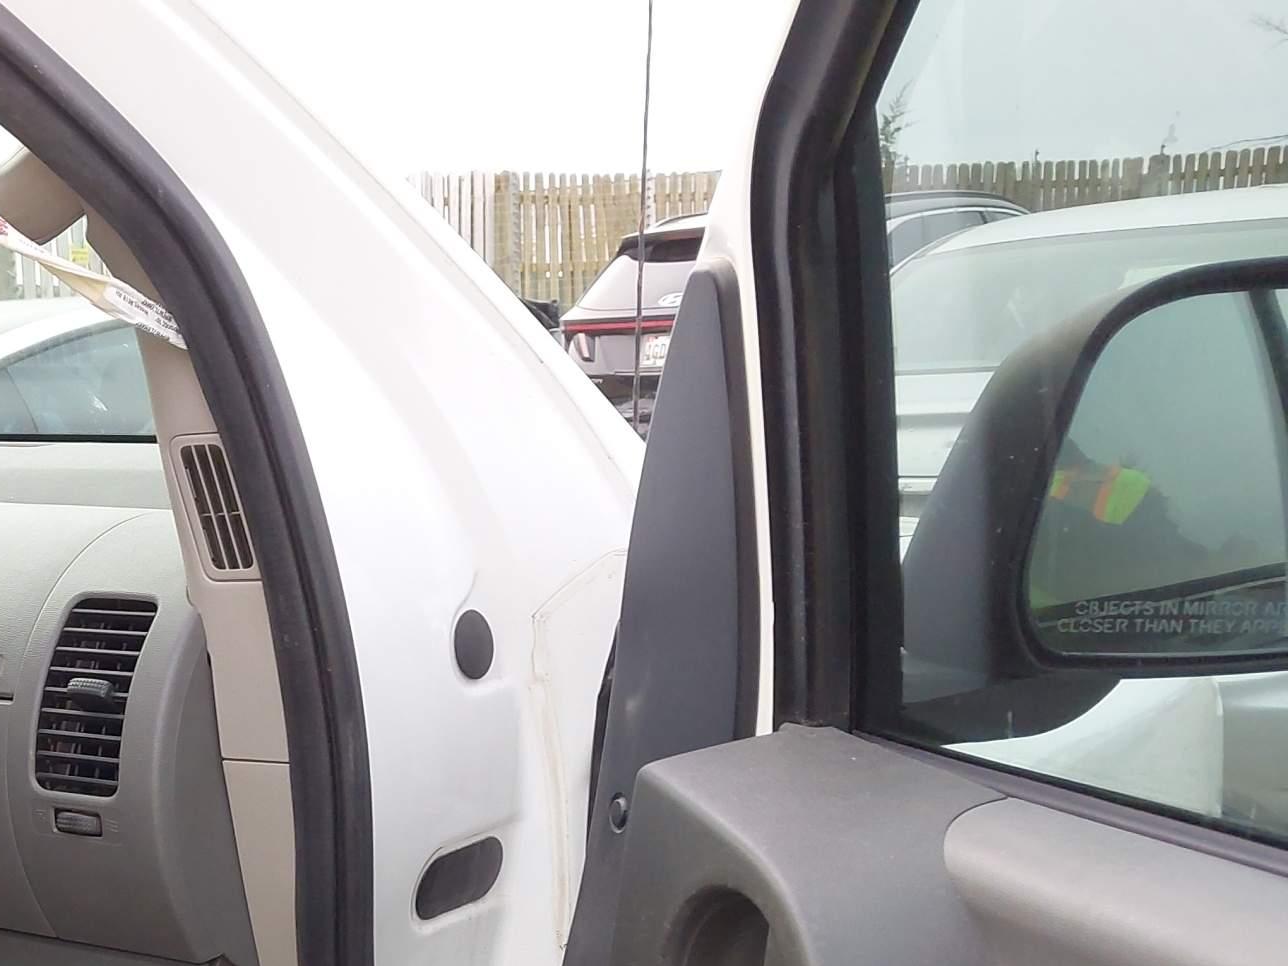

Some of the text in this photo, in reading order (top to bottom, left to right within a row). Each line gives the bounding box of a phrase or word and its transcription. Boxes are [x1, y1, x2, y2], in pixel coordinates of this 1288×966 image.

[1075, 600, 1154, 616] OBJECTS
[1159, 599, 1178, 616] IN
[1183, 600, 1256, 617] MIRROR
[1057, 618, 1128, 633] CLOSER
[1133, 618, 1182, 634] THAN
[1189, 619, 1235, 635] THEY
